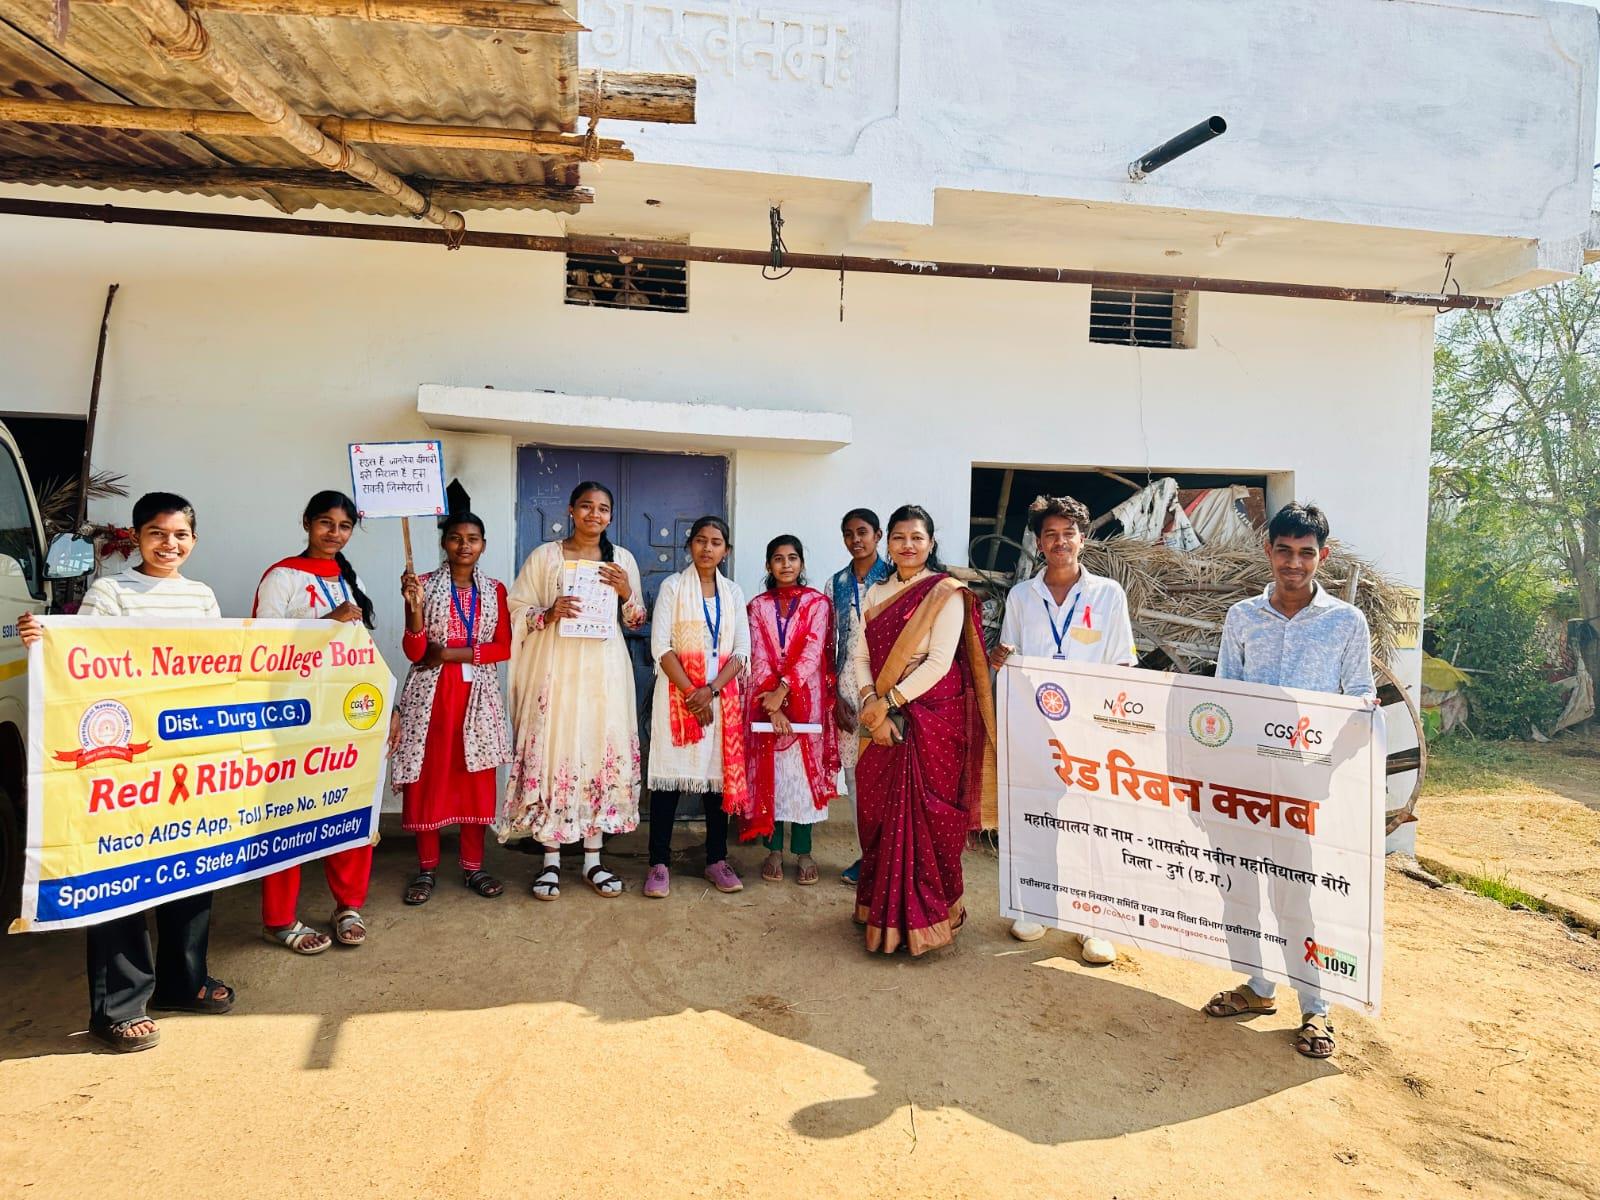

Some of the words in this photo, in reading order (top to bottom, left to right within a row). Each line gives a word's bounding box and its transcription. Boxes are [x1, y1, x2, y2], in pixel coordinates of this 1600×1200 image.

[68, 646, 142, 680] Govt.
[151, 645, 242, 677] Naveen
[250, 643, 323, 678] College
[328, 639, 375, 667] Bori
[164, 713, 203, 734] Dist.
[217, 710, 257, 729] Durg
[260, 703, 305, 727] (C.G.)
[1264, 716, 1323, 750] CGSACS
[88, 770, 161, 813] Red
[195, 757, 296, 796] Ribbon
[303, 743, 359, 775] Club
[1048, 738, 1101, 792] रेड
[1106, 748, 1203, 812] रिबन
[1209, 782, 1320, 836] क्लब
[98, 833, 144, 855] Naco
[149, 819, 192, 845] AIDS
[195, 816, 232, 837] App,
[238, 806, 261, 826] Toll
[265, 802, 294, 820] Free
[296, 795, 317, 812] No.
[322, 787, 348, 806] 1097
[57, 874, 141, 910] Sponsor
[156, 860, 191, 885] C.G.
[195, 851, 234, 875] Stete
[235, 842, 269, 865] AIDS
[272, 826, 317, 854] Control
[320, 816, 362, 840] Society
[1024, 812, 1090, 835] महाविद्यालय
[1093, 824, 1109, 839] का
[1111, 828, 1134, 844] नाम
[1147, 837, 1200, 859] शासकीय
[1203, 847, 1237, 869] नवीन
[1239, 856, 1319, 886] महाविद्यालय
[1121, 848, 1152, 871] जिला
[1166, 861, 1185, 880] दुर्ग
[1188, 866, 1232, 892] (छ.ग.)
[1264, 932, 1288, 947] शासन
[1324, 956, 1356, 977] 1097
